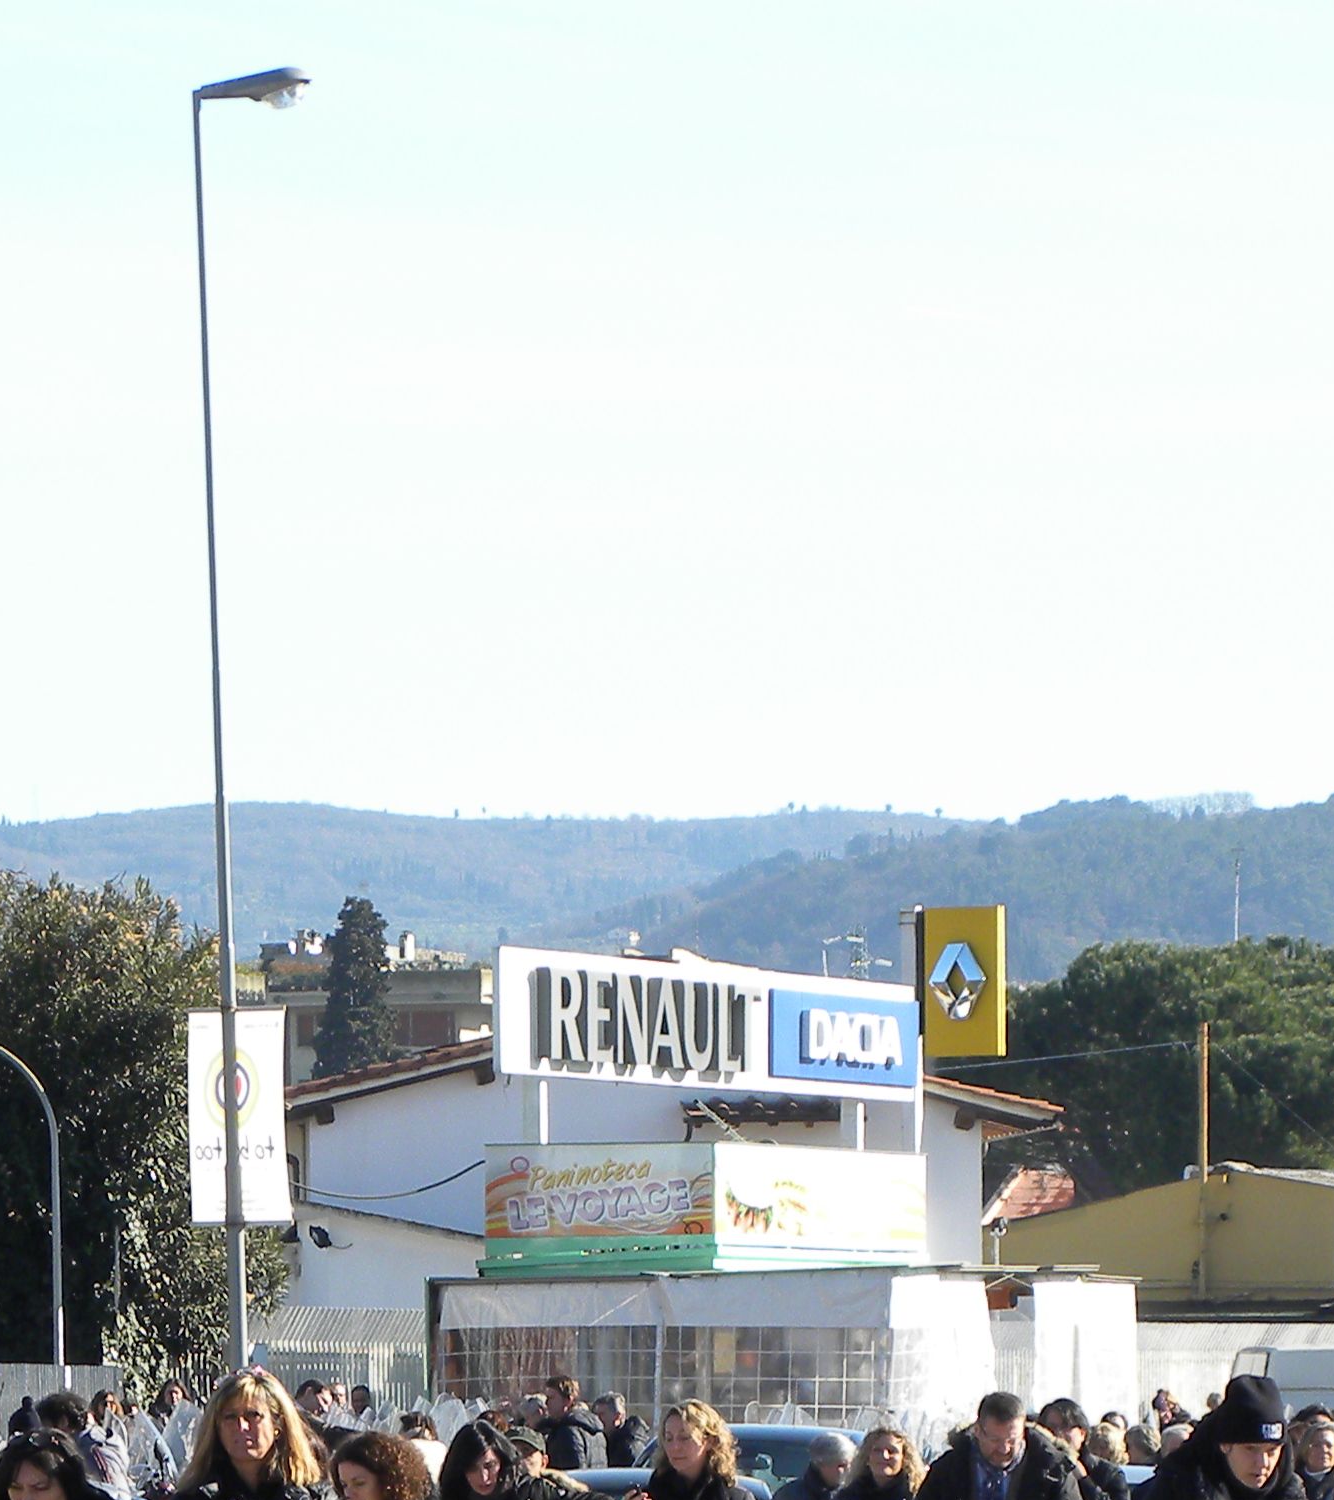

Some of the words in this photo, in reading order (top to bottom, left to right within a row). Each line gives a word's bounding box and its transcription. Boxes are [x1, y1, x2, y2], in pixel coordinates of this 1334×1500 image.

[537, 966, 762, 1076] RENAULT
[804, 1008, 903, 1068] DACIA
[528, 1157, 652, 1191] Paninoteca
[508, 1193, 549, 1232] LE
[549, 1178, 692, 1226] VOYAGE
